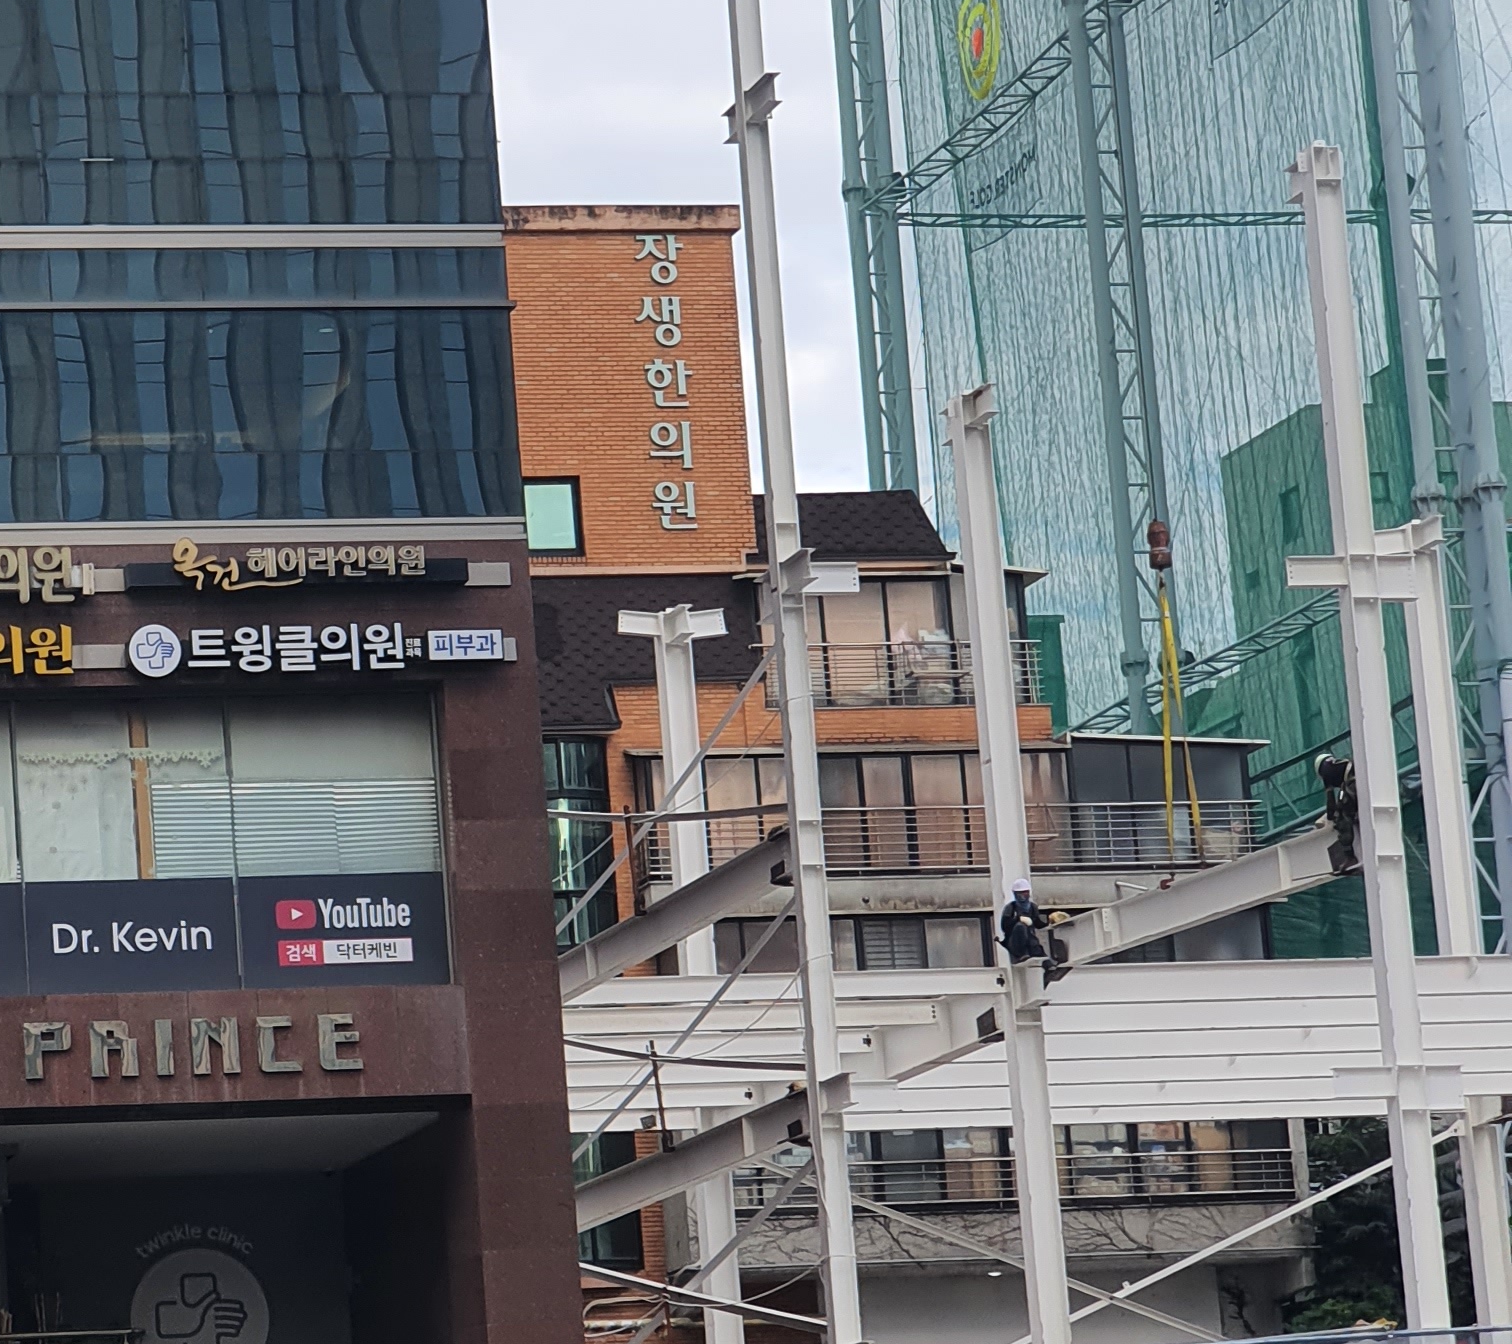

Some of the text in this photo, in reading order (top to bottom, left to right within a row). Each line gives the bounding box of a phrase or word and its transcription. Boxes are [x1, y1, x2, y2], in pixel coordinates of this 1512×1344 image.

[634, 233, 699, 531] 장생한의원
[245, 544, 427, 578] 헤어라인의원
[187, 621, 406, 673] 트윙클의원
[433, 632, 497, 657] 피부과
[318, 896, 411, 930] YouTube
[51, 919, 213, 955] Dr. Kevin
[284, 941, 399, 963] 검색 닥터케빈
[135, 1223, 254, 1259] twinkle clinic
